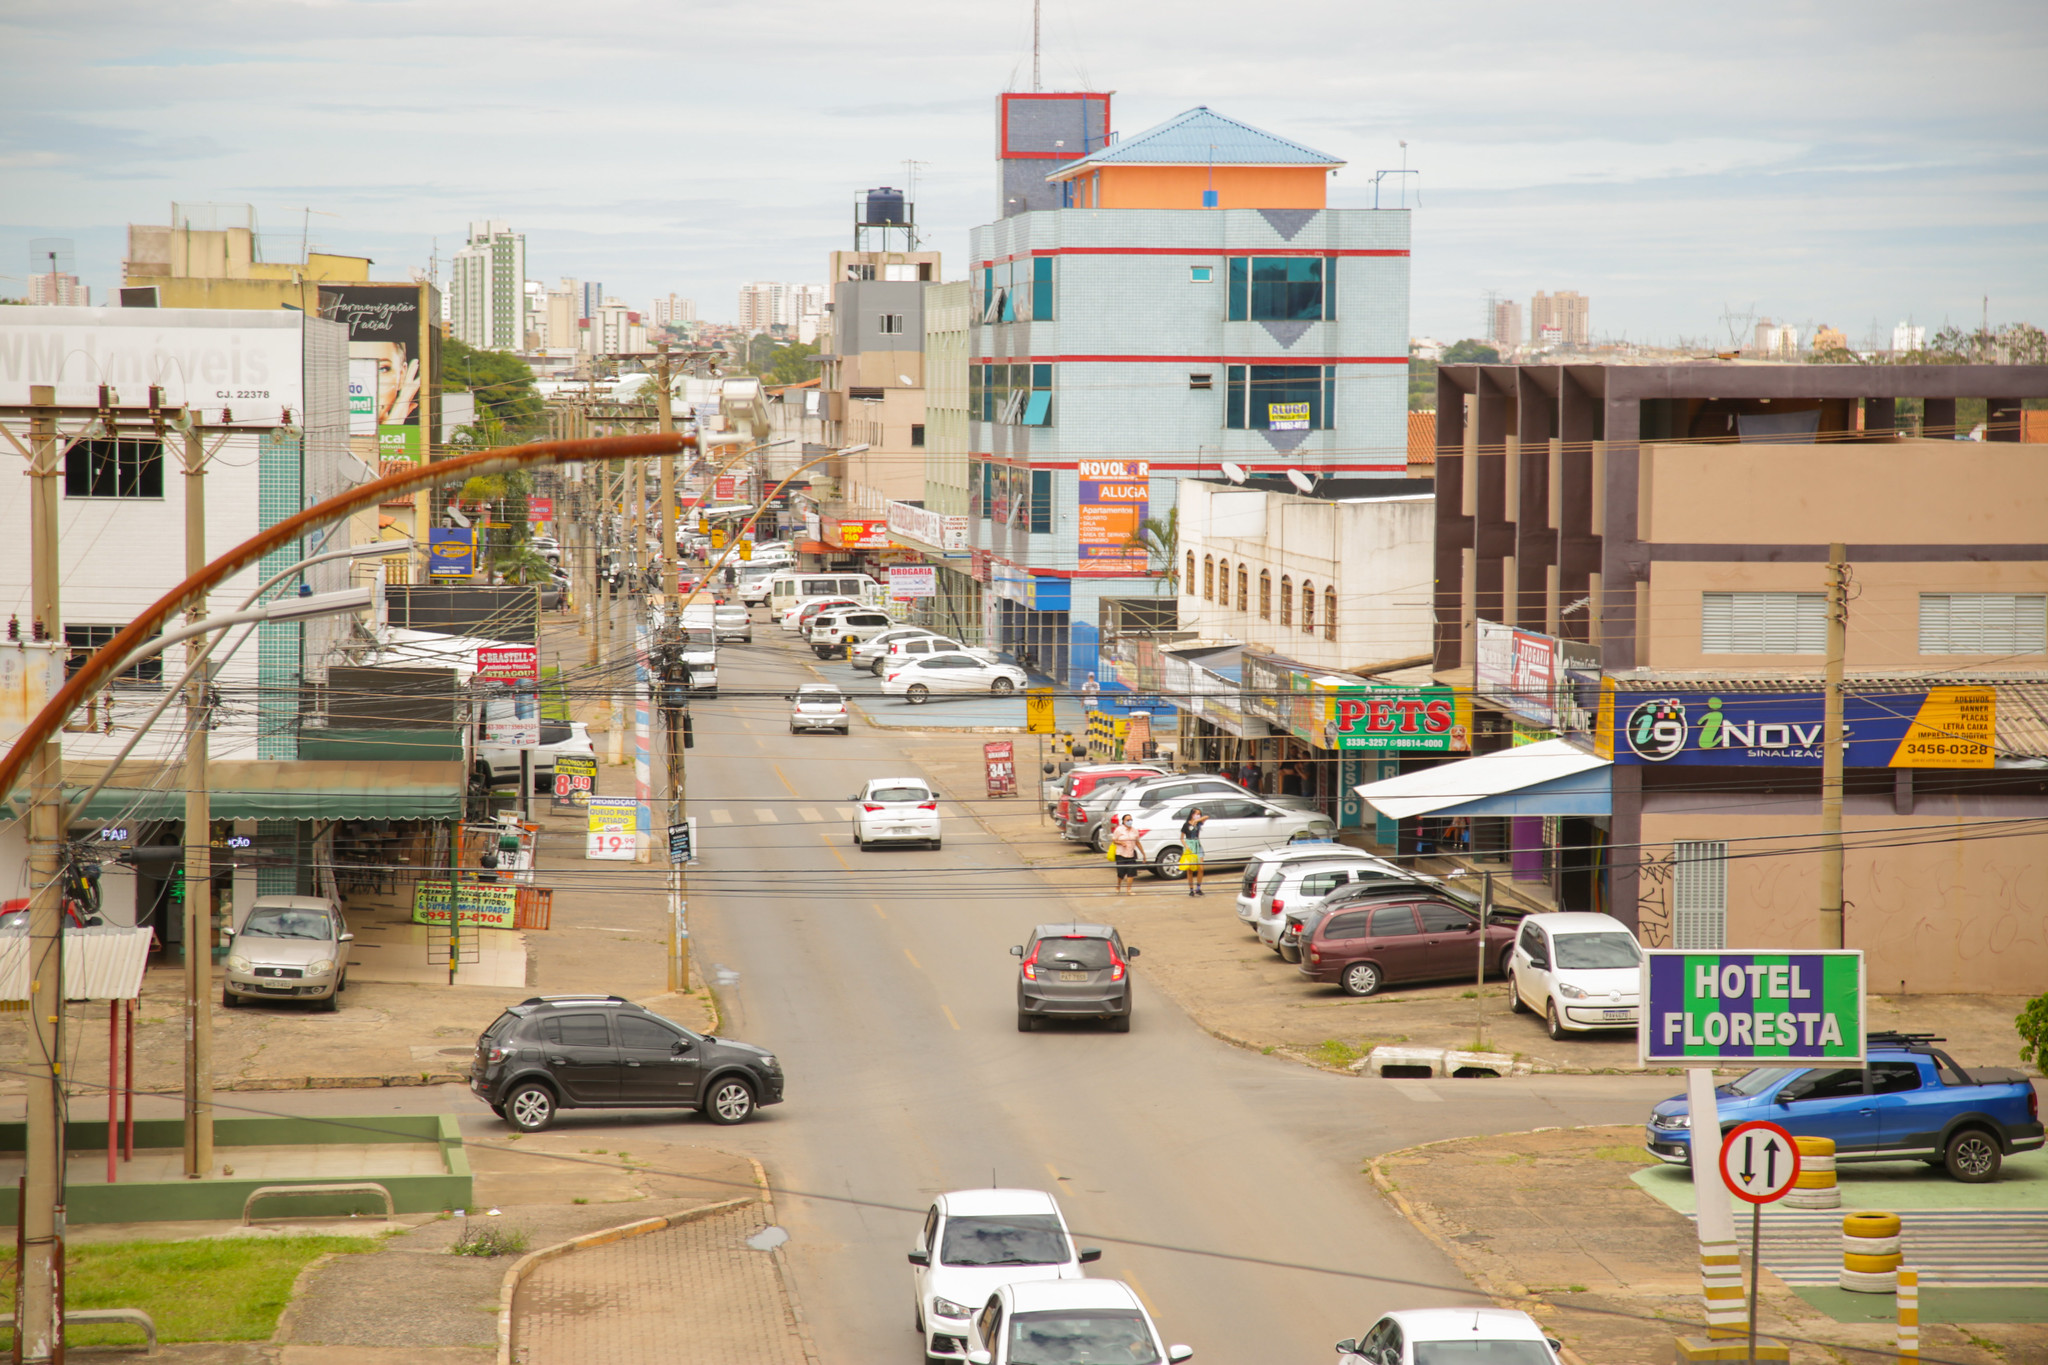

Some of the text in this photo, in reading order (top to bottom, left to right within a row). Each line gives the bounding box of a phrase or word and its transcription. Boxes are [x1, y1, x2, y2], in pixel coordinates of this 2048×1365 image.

[324, 294, 416, 320] Harmonização
[348, 312, 393, 336] Facial
[237, 390, 270, 399] 22378
[1271, 404, 1308, 415] ALUGO
[1080, 462, 1147, 476] NOVOLAR
[1101, 486, 1148, 498] ALUGA
[891, 567, 932, 576] DROGARIA
[487, 652, 529, 663] BRASTELL
[486, 670, 535, 678] STRAGOU?
[1337, 699, 1452, 733] PETS
[1907, 744, 1988, 755] 3456-0328
[558, 758, 594, 767] PROMOÇÃO
[591, 798, 636, 807] PROMOÇÃO
[589, 808, 615, 816] QUEIJO
[1695, 964, 1811, 999] HOTEL
[1663, 1012, 1844, 1047] FLORESTA
